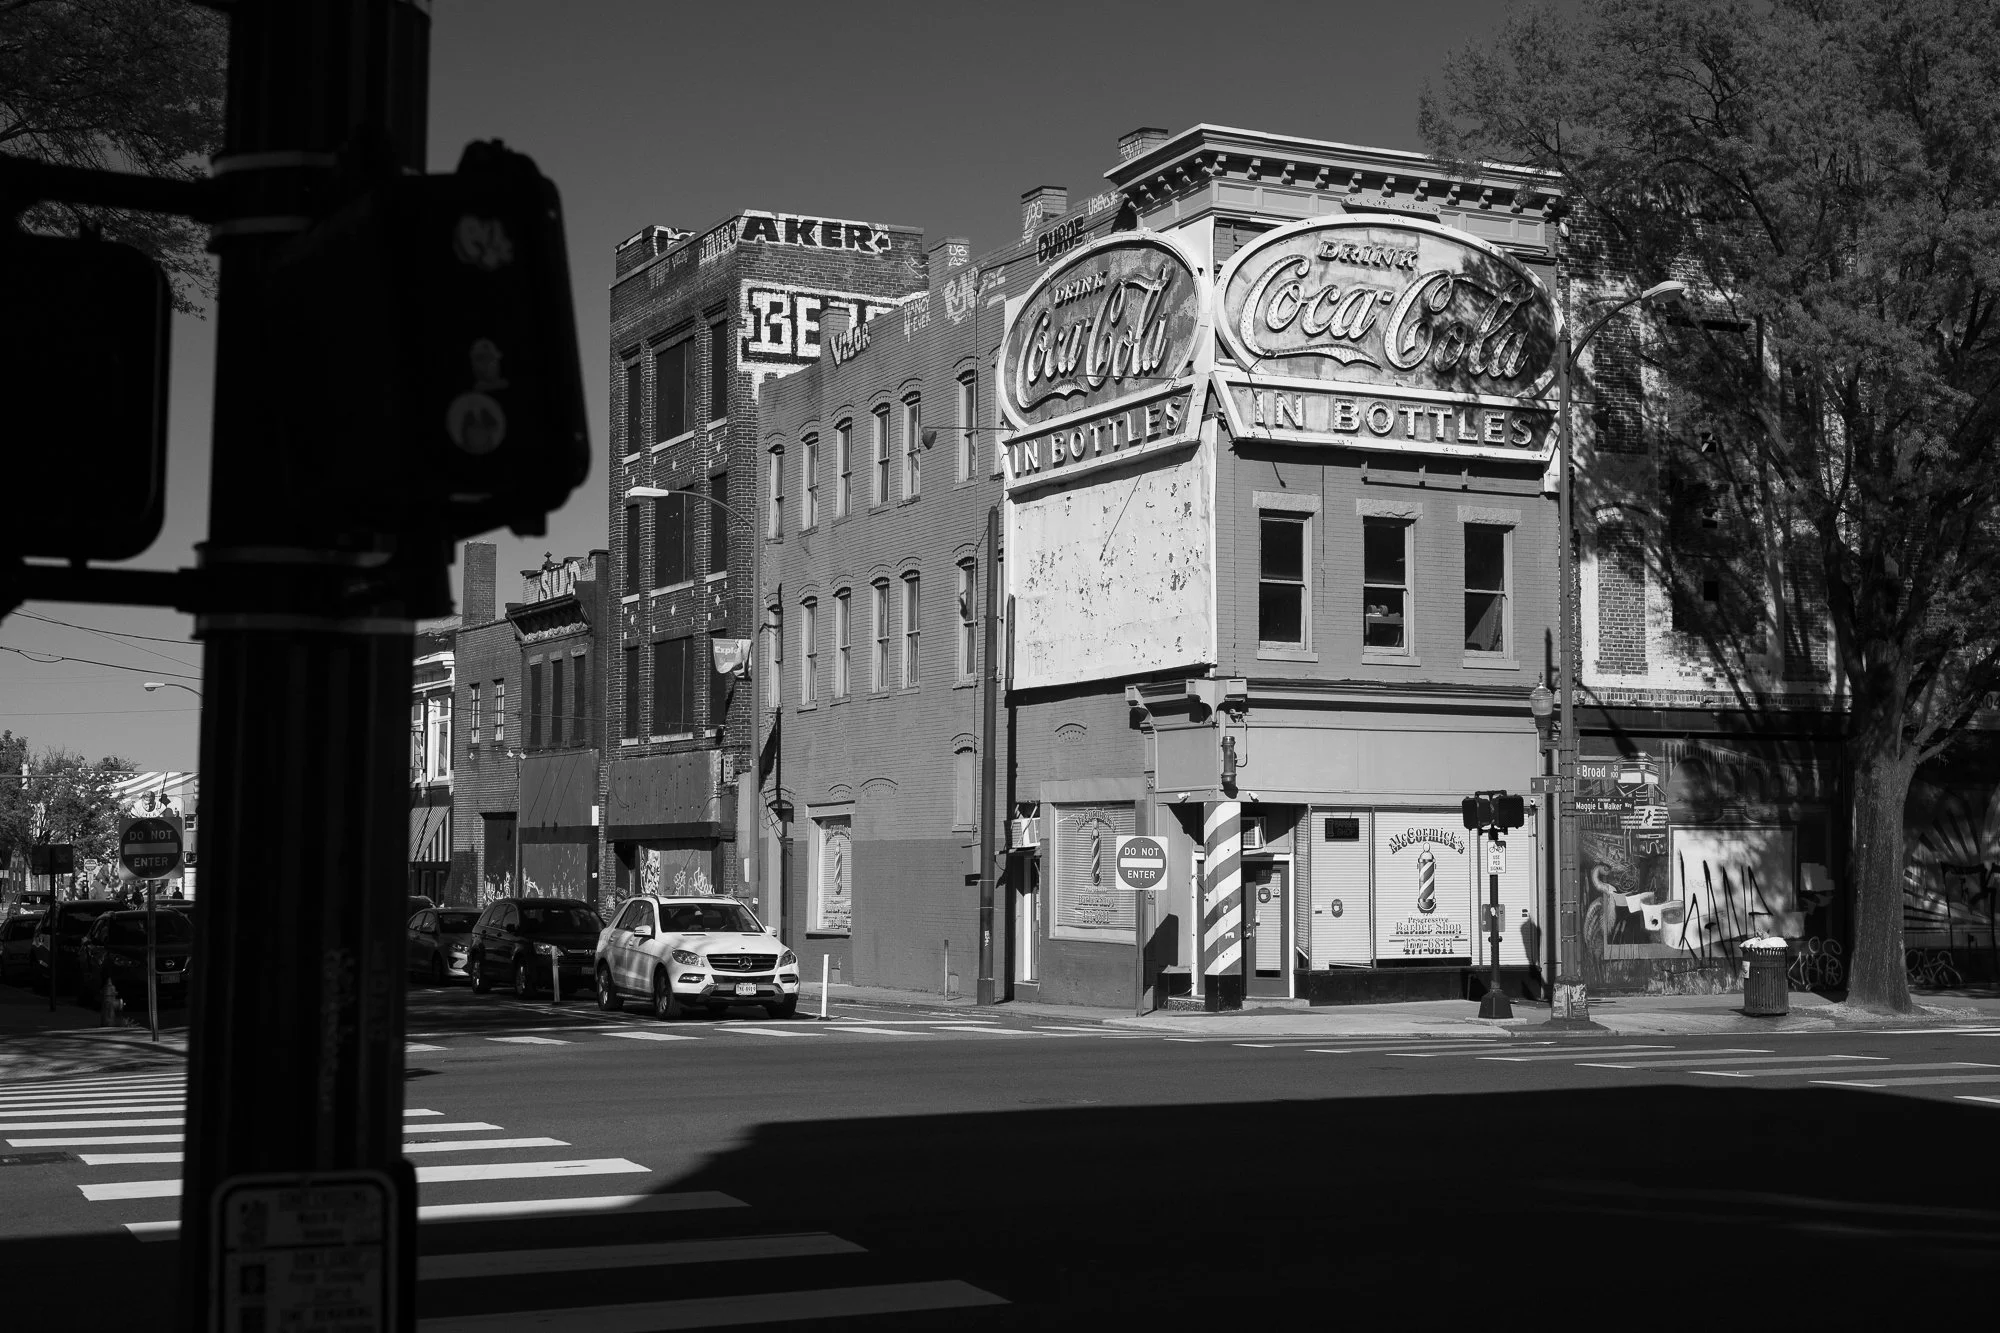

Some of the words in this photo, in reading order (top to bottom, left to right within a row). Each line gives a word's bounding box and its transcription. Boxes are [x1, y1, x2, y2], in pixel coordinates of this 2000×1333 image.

[1317, 240, 1419, 270] DRINK
[1054, 271, 1107, 308] DRINK
[1239, 253, 1535, 379] Coca-Cola
[1016, 265, 1174, 413] Coca-Cola
[1254, 391, 1303, 429] IN
[1333, 397, 1533, 446] BOTTLES
[1014, 439, 1041, 479] IN
[1051, 397, 1181, 466] BOTTLES
[1576, 767, 1581, 775] E
[1582, 765, 1606, 777] Broad
[1575, 801, 1596, 812] Maggie
[1603, 801, 1622, 810] Walker
[129, 831, 144, 841] DO
[150, 830, 173, 840] NOT
[1124, 846, 1137, 856] DO
[1141, 846, 1159, 856] NOT
[133, 857, 169, 868] ENTER
[1127, 870, 1156, 879] ENTER
[1395, 921, 1431, 932] Barber
[1435, 921, 1462, 934] Shop
